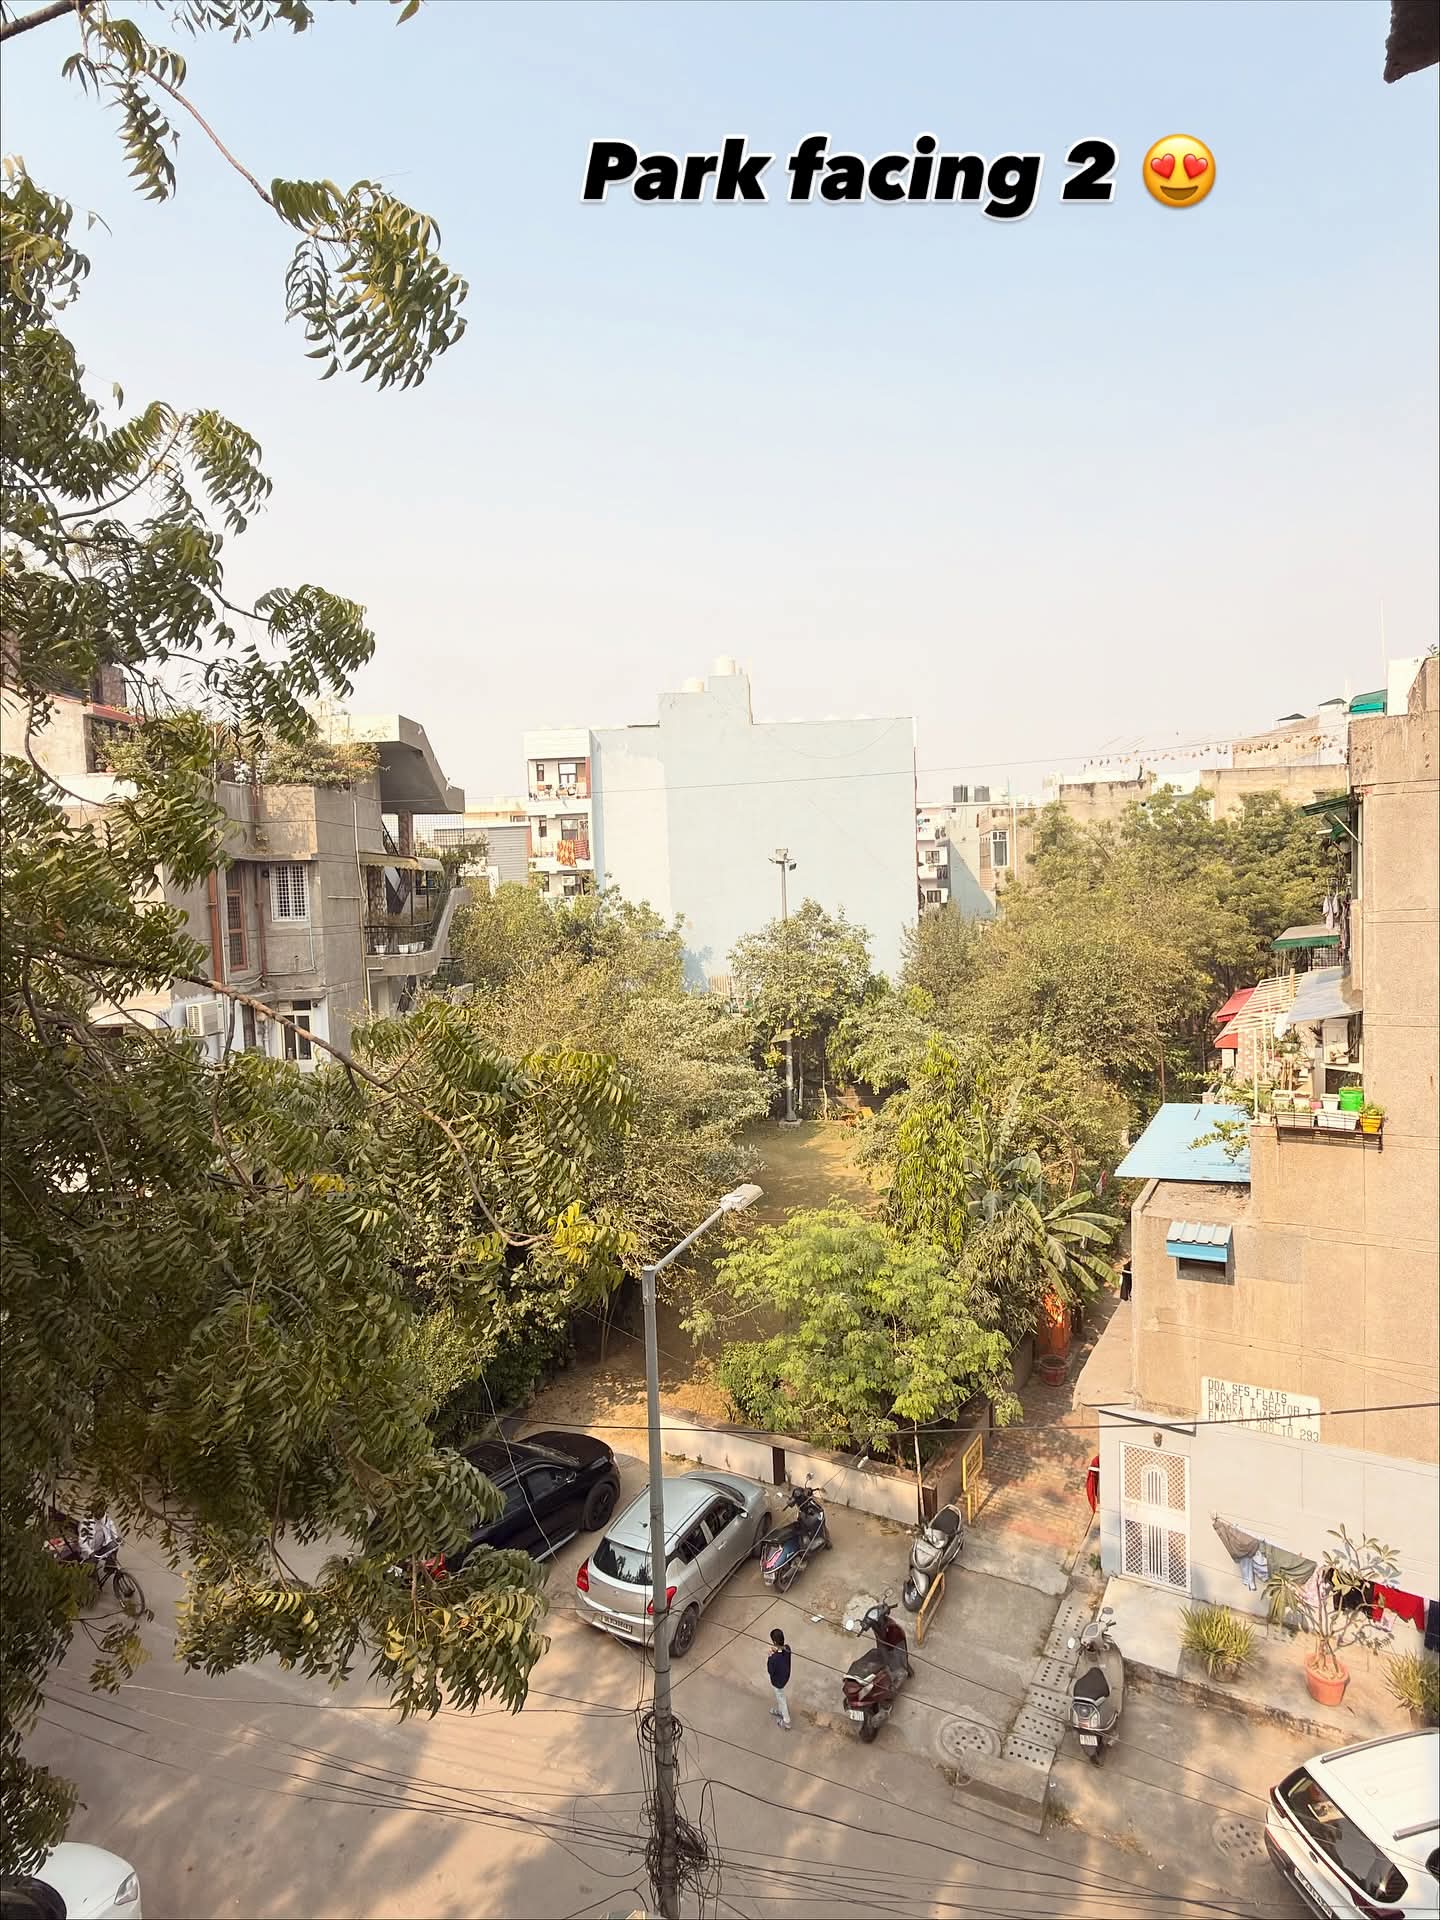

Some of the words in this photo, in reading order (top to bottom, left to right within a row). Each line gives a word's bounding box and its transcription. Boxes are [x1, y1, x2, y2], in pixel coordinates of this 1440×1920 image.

[1208, 1379, 1226, 1392] DDA
[1256, 1388, 1287, 1404] FLATS
[1208, 1390, 1243, 1409] POCKET
[1262, 1400, 1299, 1417] SECTOR
[1208, 1400, 1244, 1417] DWARKA
